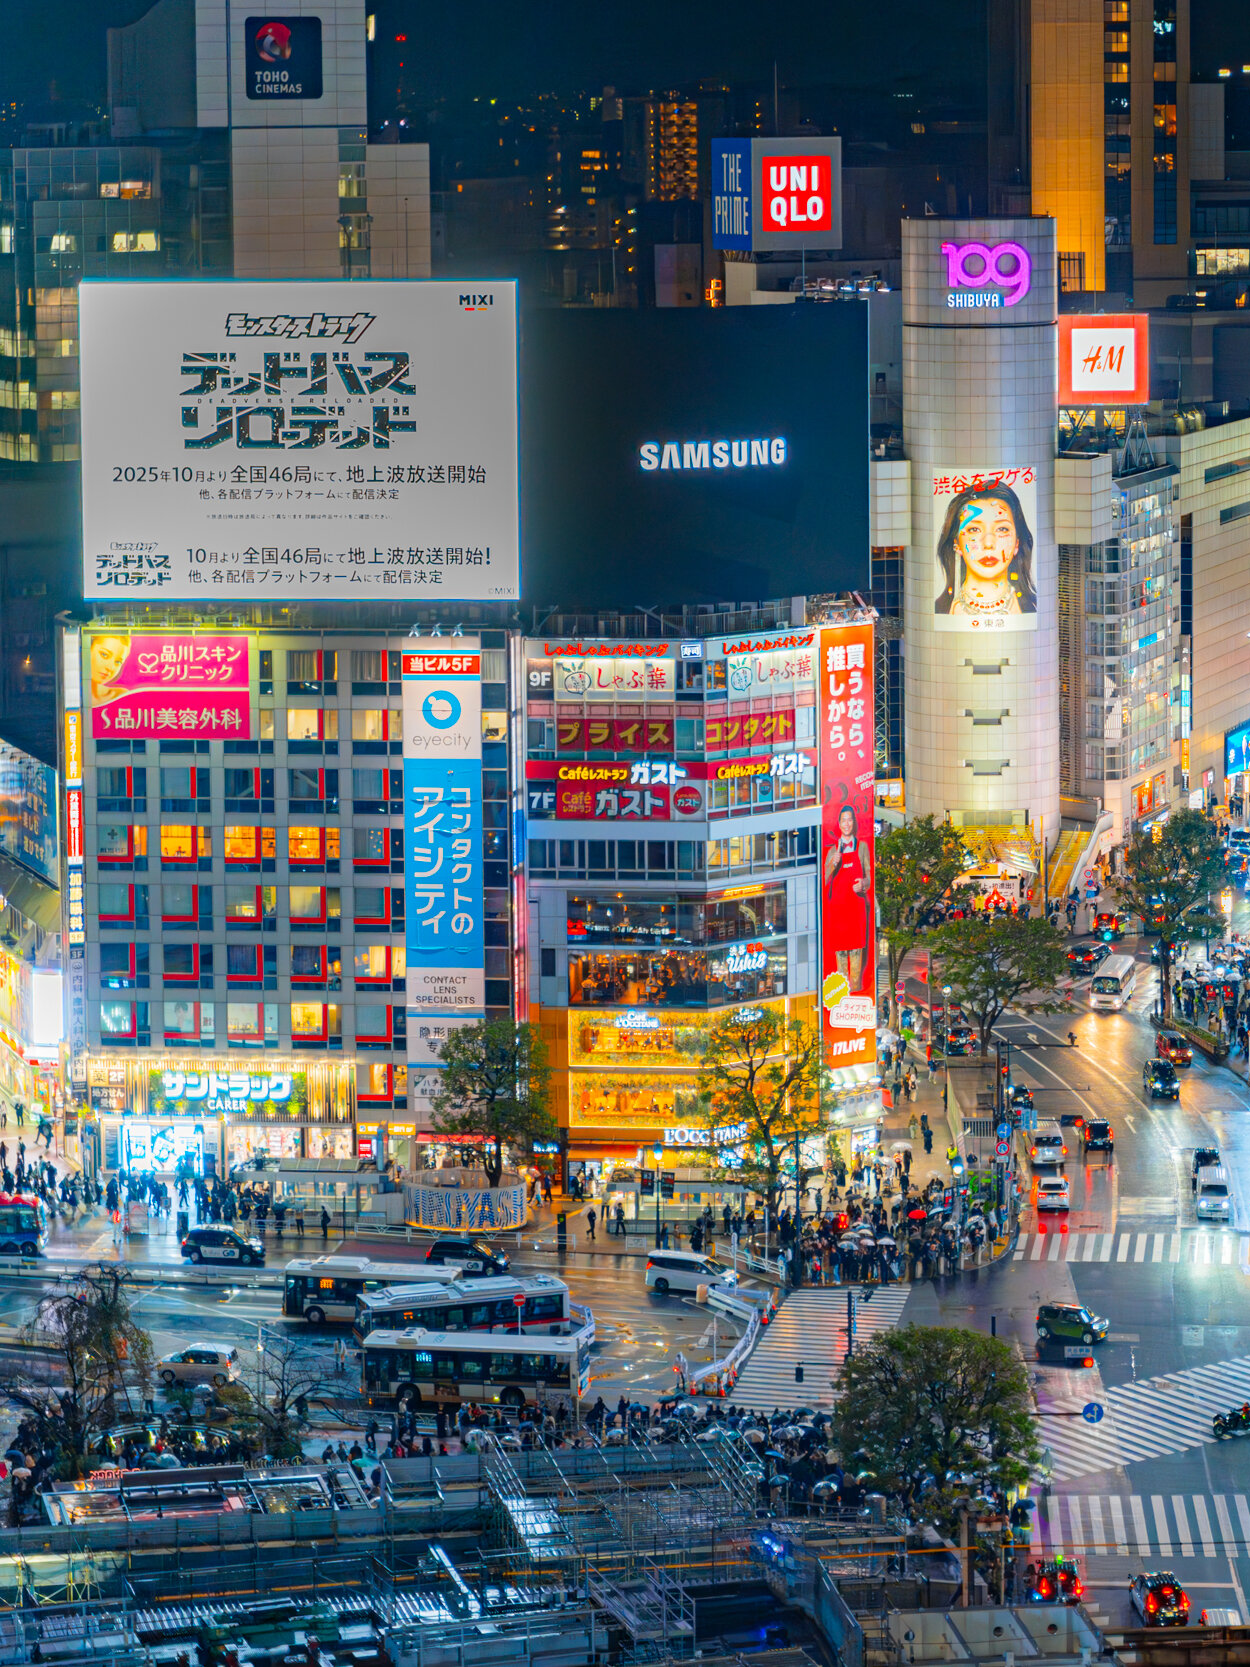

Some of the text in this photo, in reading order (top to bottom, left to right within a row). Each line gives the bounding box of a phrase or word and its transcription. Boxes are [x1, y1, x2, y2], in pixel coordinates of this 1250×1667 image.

[255, 71, 289, 83] TOHO
[255, 84, 302, 94] CINEMAS
[721, 153, 742, 193] THE
[769, 165, 819, 192] UNI
[714, 196, 749, 236] PRIME
[769, 196, 824, 227] QLO
[940, 241, 1032, 307] 109
[459, 294, 494, 306] MIXI
[947, 293, 1000, 308] SHIBUYA
[225, 312, 378, 344] モンスターストライク
[1082, 345, 1126, 374] H&M
[179, 351, 417, 396] デッドバス
[182, 406, 417, 450] リロデッド
[639, 437, 787, 471] SAMSUNG
[160, 644, 242, 663] 品川スキン
[544, 643, 669, 657] しゃぶしゃぶバイキング
[160, 663, 234, 682] クリニック
[409, 656, 473, 673] 当ビル5F
[757, 653, 813, 683] しゃぶ葉
[529, 671, 551, 687] 9F
[596, 666, 668, 691] しゃぶ葉
[114, 707, 243, 731] 品川美容外科
[706, 713, 793, 744] コンタクト
[412, 732, 472, 752] eyecity
[557, 721, 671, 745] プライス
[630, 761, 688, 785] ガスト
[769, 752, 811, 777] ガスト
[529, 791, 556, 809] 7F
[561, 791, 593, 805] Café
[595, 788, 665, 817] ガスト
[676, 798, 700, 807] ガスト
[412, 787, 446, 936] アイシティ
[450, 787, 474, 936] コンタクトの
[726, 951, 768, 975] Ushi8
[423, 976, 467, 985] CONTACT
[433, 986, 457, 995] LENS
[415, 995, 476, 1005] SPECIALISTS
[835, 1011, 874, 1022] SHOPPING!
[832, 1037, 867, 1056] 17LIVE
[94, 1070, 106, 1083] 薬
[108, 1071, 125, 1082] 2F
[162, 1070, 293, 1100] サンドラッグ
[207, 1098, 248, 1112] CARER
